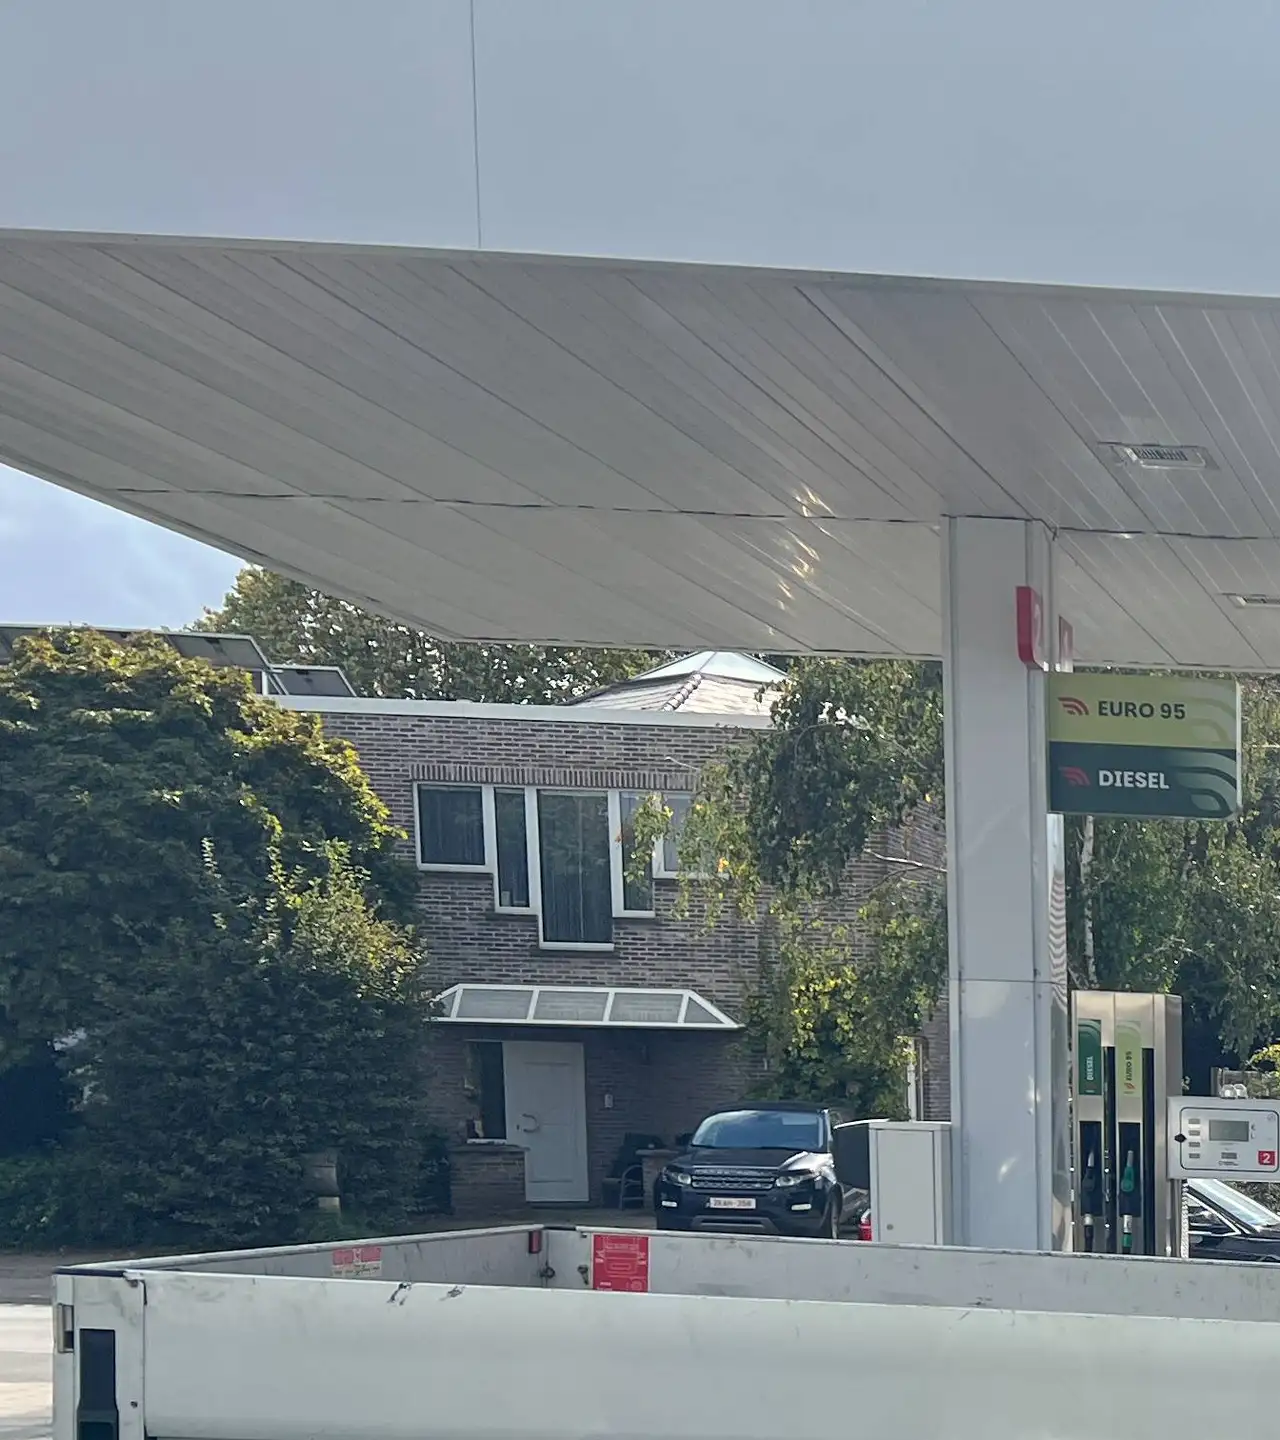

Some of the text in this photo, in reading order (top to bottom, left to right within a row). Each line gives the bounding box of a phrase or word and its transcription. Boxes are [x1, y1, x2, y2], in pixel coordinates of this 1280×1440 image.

[1098, 700, 1186, 720] EURO 95
[1098, 770, 1170, 789] DIESEL
[1262, 1152, 1271, 1164] 2
